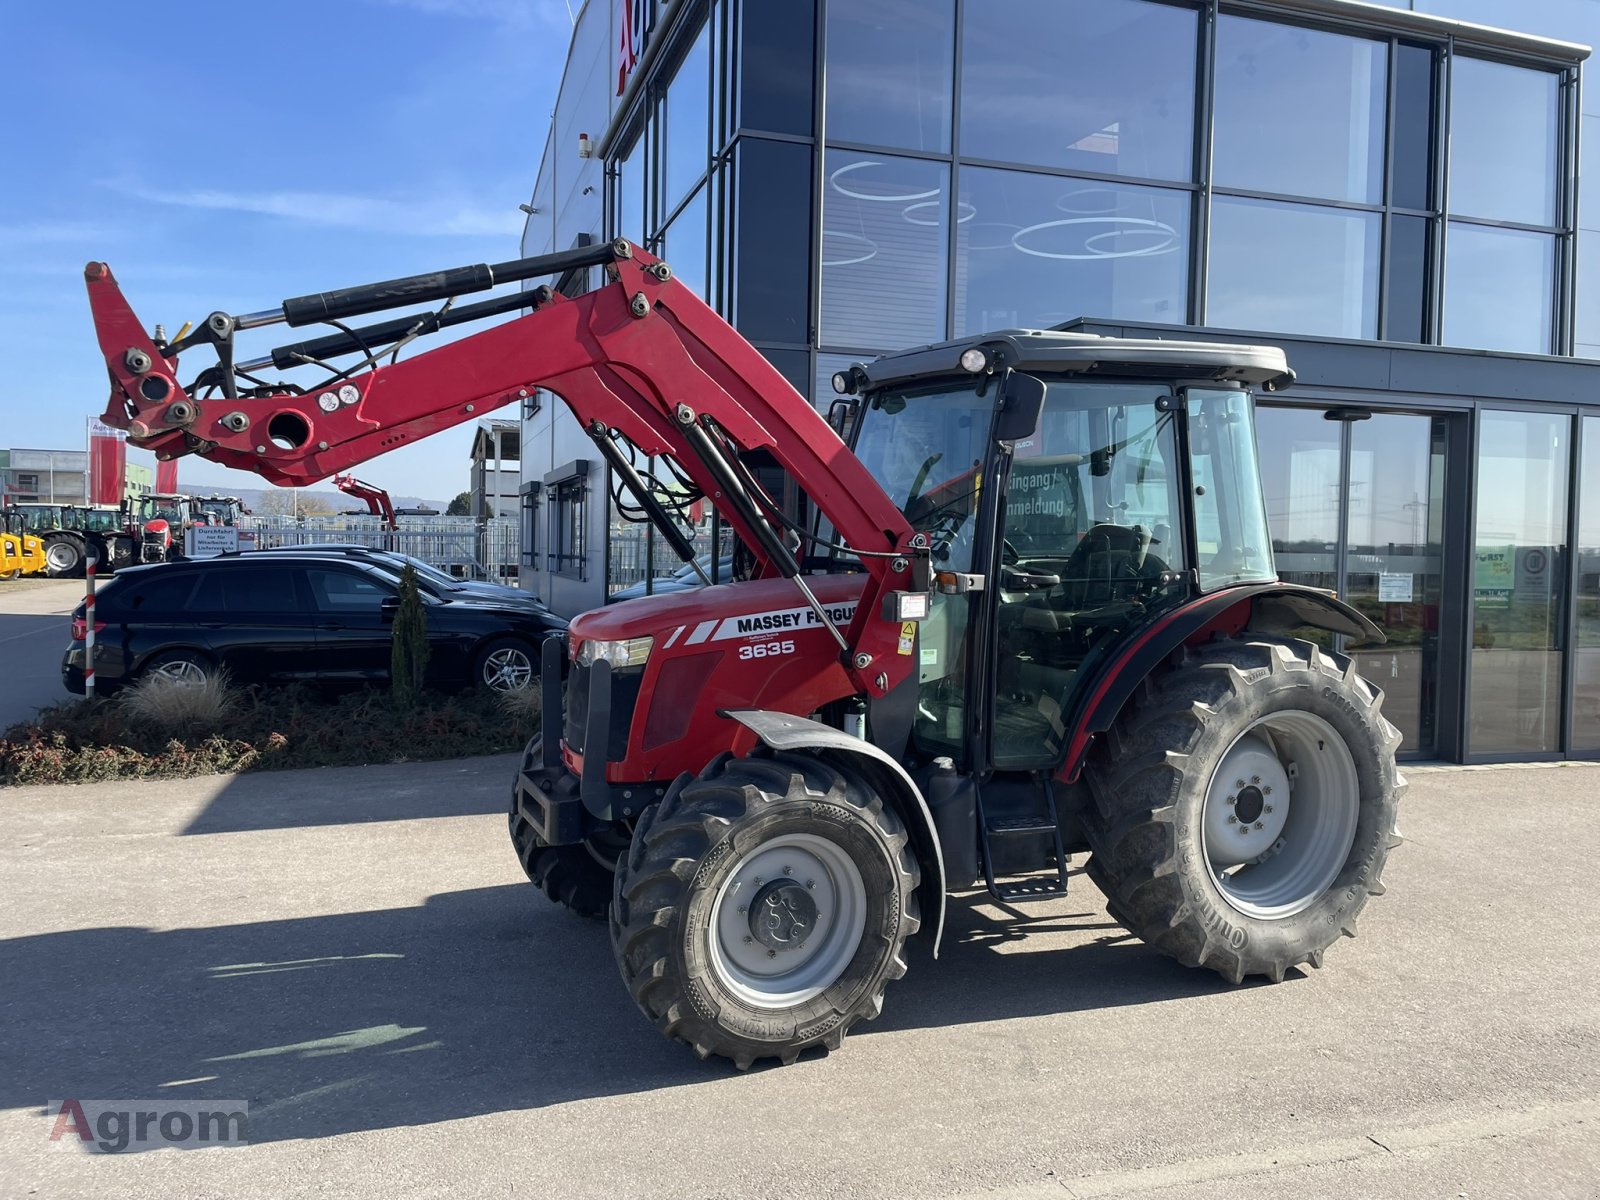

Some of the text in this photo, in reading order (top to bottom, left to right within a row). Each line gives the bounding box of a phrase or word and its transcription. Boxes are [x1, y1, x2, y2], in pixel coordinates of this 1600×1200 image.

[1006, 497, 1064, 517] nmeldung
[737, 613, 801, 633] MASSEY
[739, 640, 796, 660] 3635
